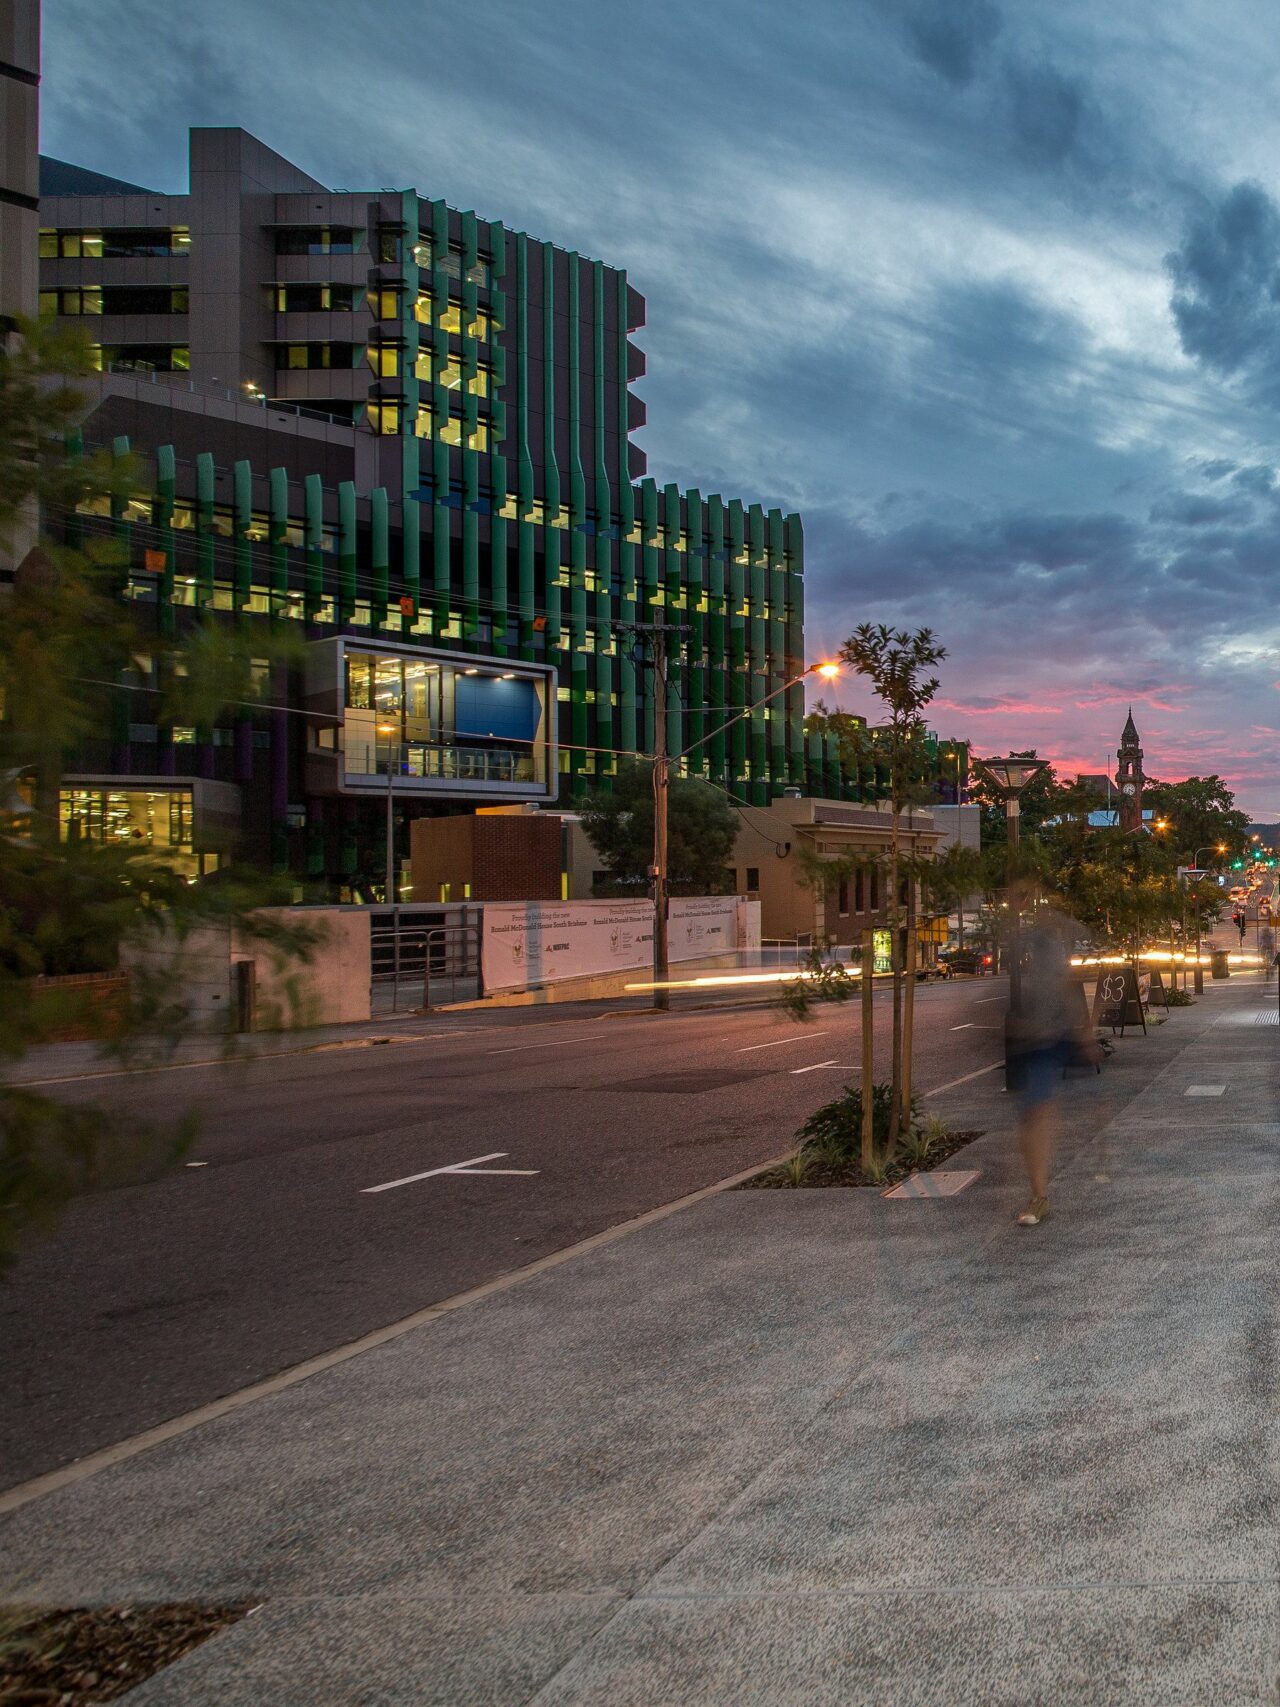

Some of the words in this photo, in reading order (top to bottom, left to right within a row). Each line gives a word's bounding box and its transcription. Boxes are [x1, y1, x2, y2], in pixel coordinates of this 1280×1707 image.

[490, 924, 510, 933] Ronald
[510, 922, 537, 931] McDonald
[567, 919, 588, 927] Brisbane
[1100, 973, 1125, 1002] $3
